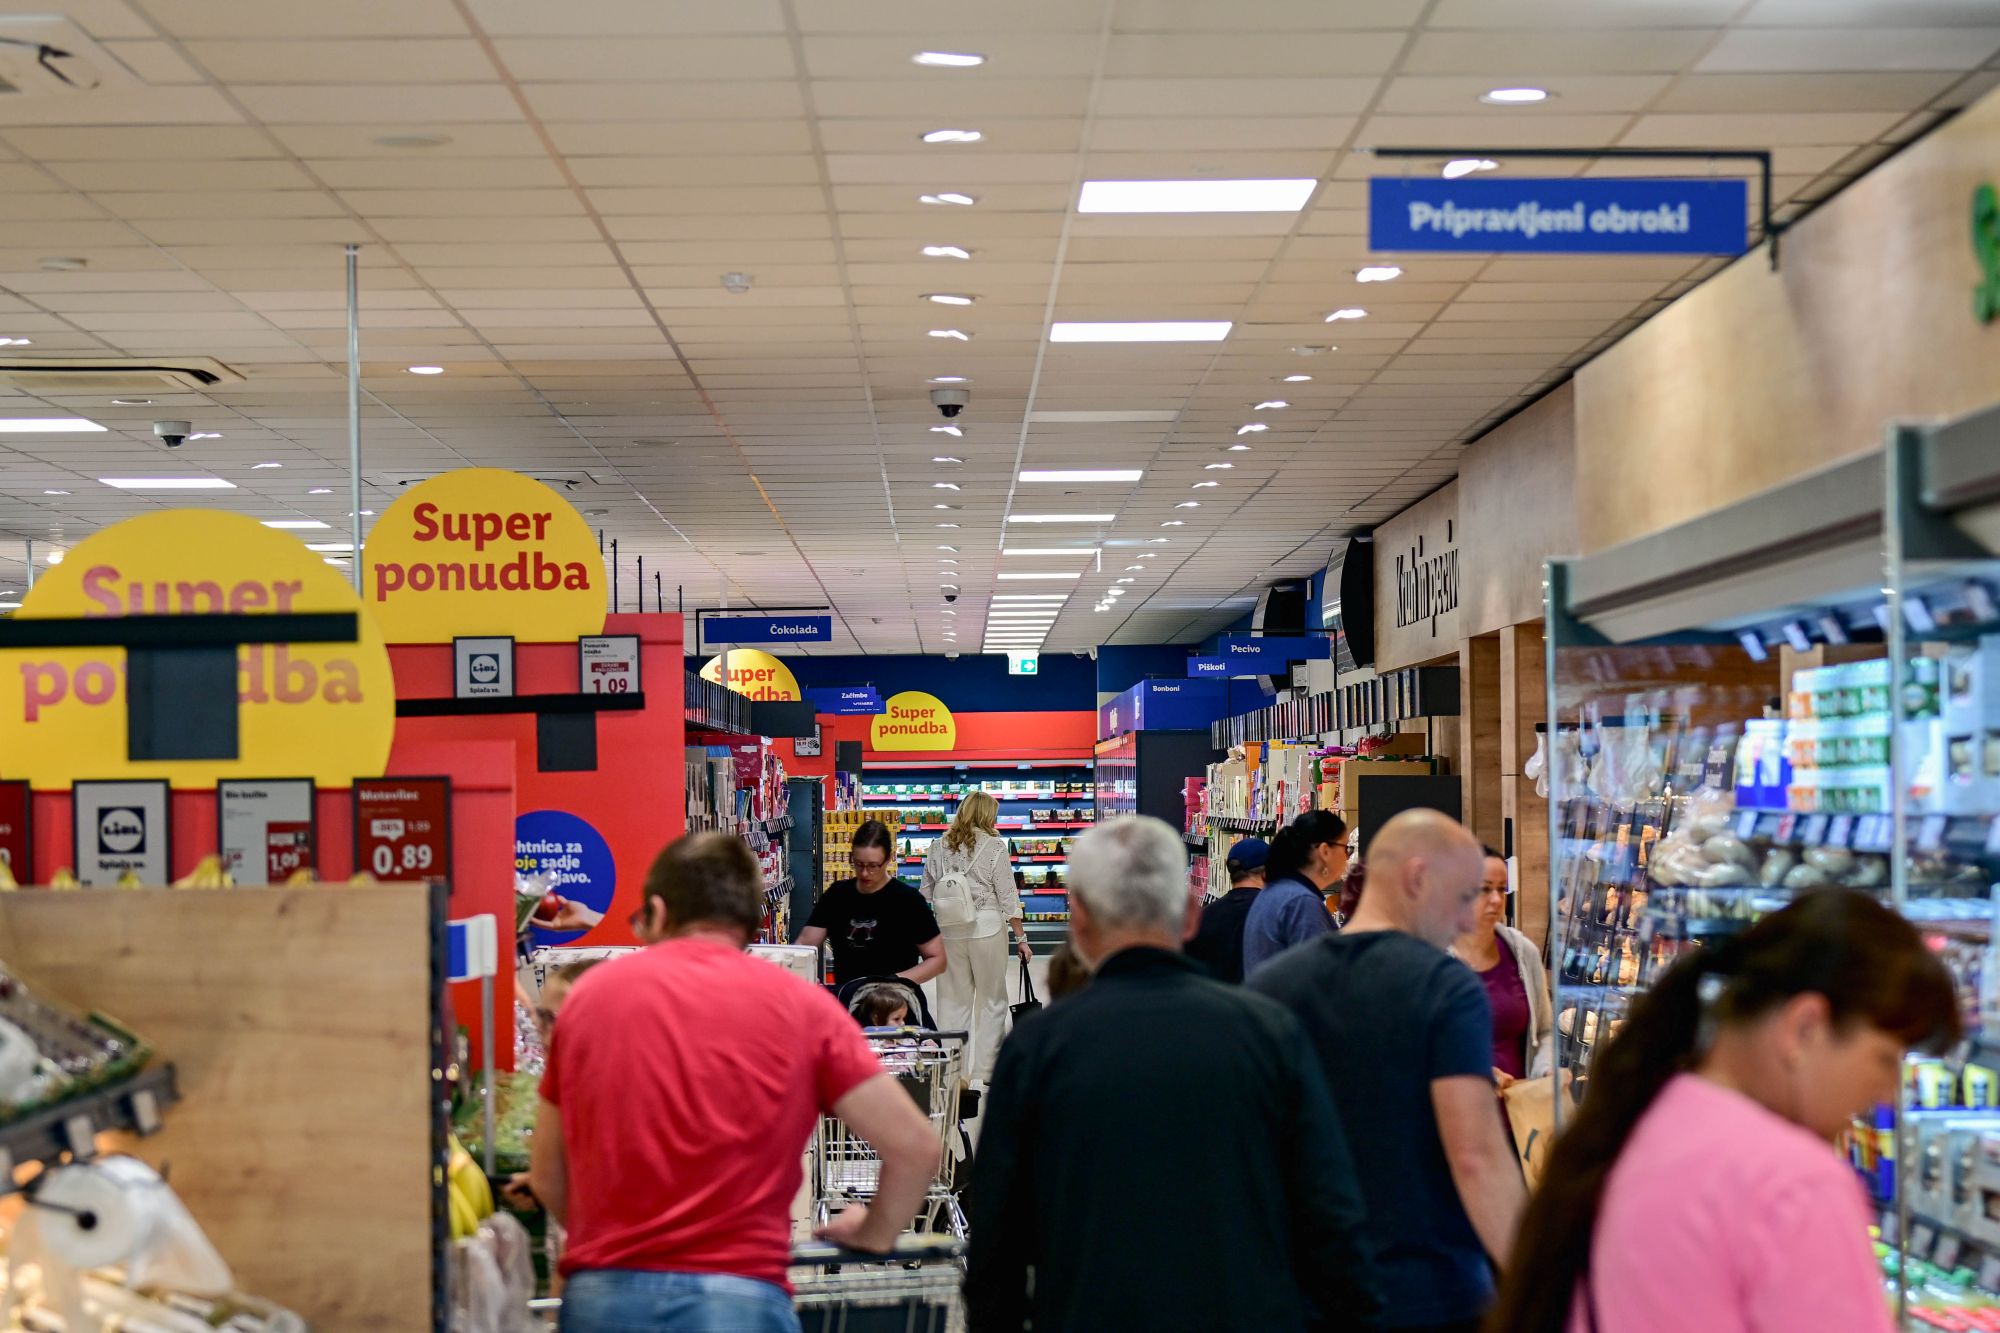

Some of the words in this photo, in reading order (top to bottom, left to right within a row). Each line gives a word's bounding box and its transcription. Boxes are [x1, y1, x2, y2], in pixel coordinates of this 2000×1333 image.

[1408, 199, 1585, 239] Pripravljeni
[1589, 200, 1690, 233] obroki
[412, 502, 552, 551] Super
[374, 551, 590, 602] ponudba
[1429, 519, 1460, 638] peciv
[81, 564, 303, 618] Super
[770, 624, 818, 635] Čokolada
[1231, 644, 1261, 653] Pecivo
[714, 665, 776, 686] Super
[1198, 662, 1226, 671] Piškoti
[19, 643, 364, 723] podba
[890, 706, 936, 721] Super
[879, 722, 947, 737] ponudba
[515, 839, 563, 853] htnica
[566, 843, 583, 853] za
[373, 845, 432, 874] 0.89
[514, 855, 537, 871] oje
[541, 855, 581, 871] sadje
